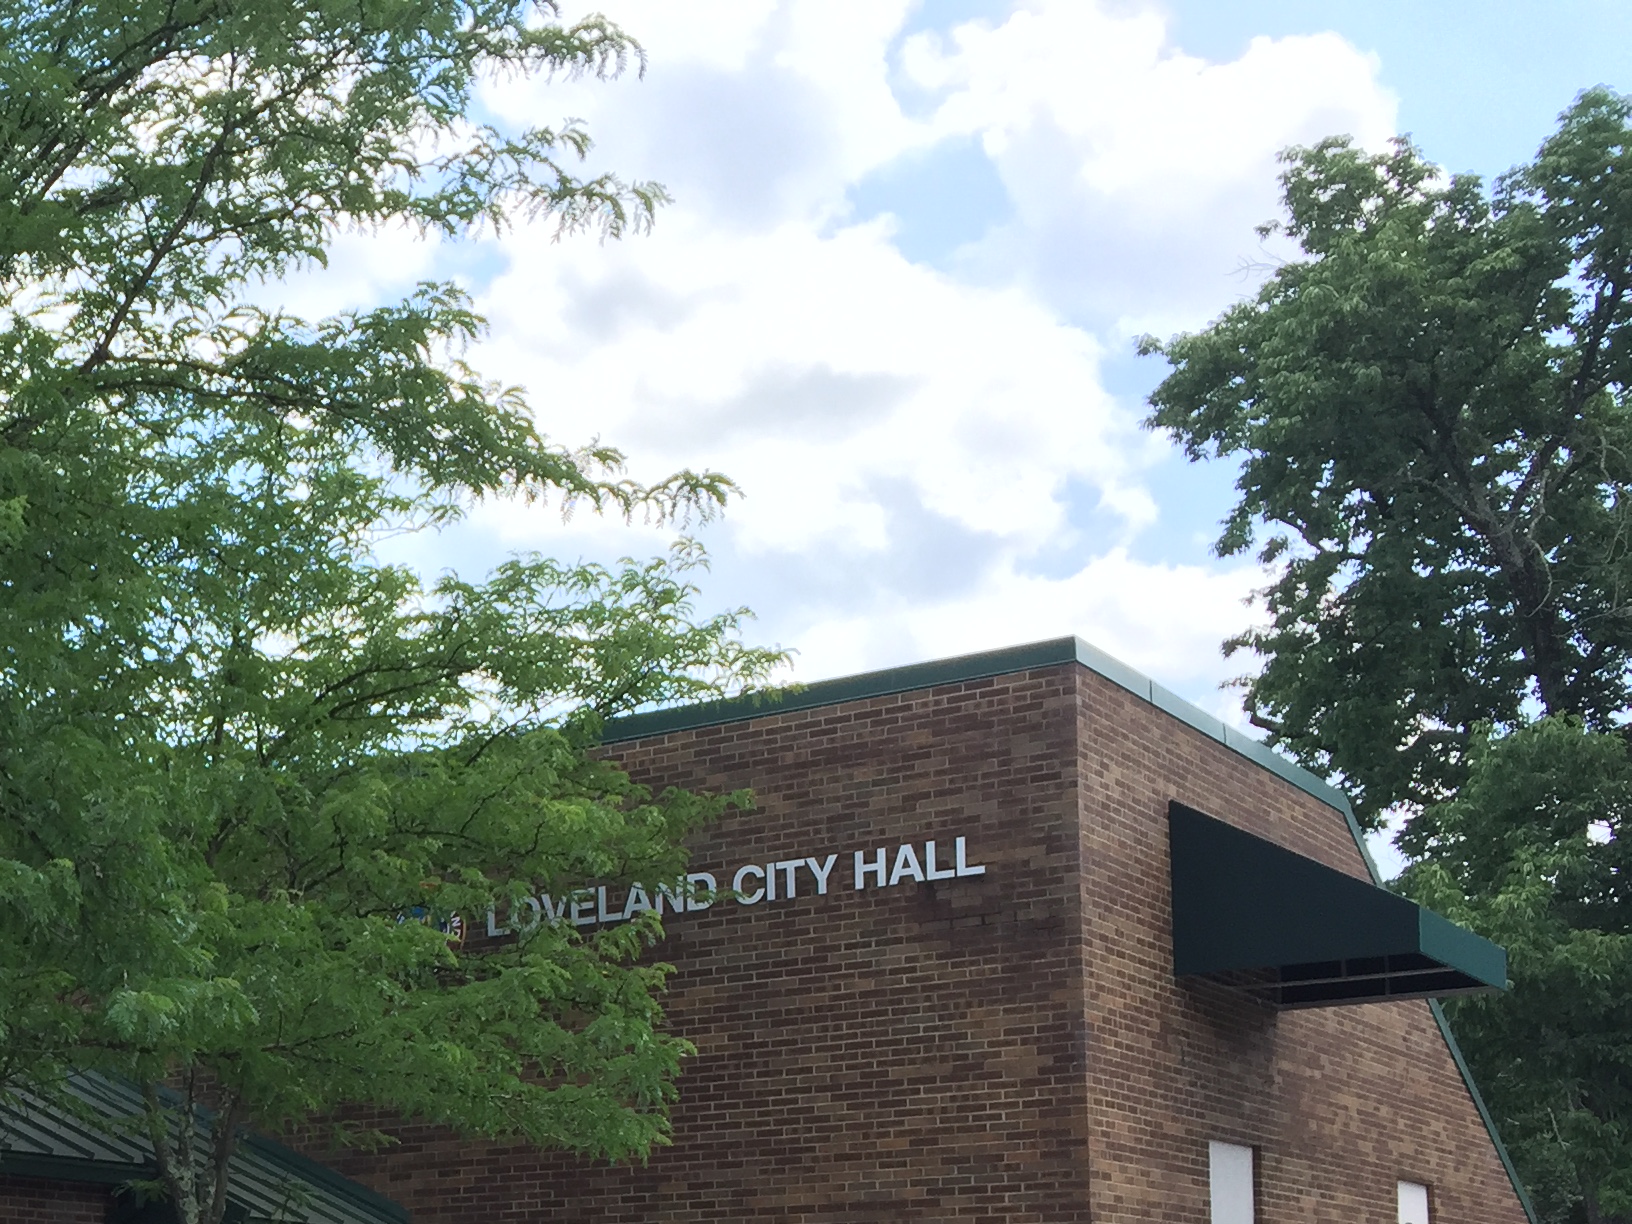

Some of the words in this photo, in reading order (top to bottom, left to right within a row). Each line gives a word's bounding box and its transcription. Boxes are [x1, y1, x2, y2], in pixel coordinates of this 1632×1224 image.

[486, 872, 718, 937] LOVELAND
[732, 853, 838, 905] CITY
[854, 836, 986, 890] HALL
